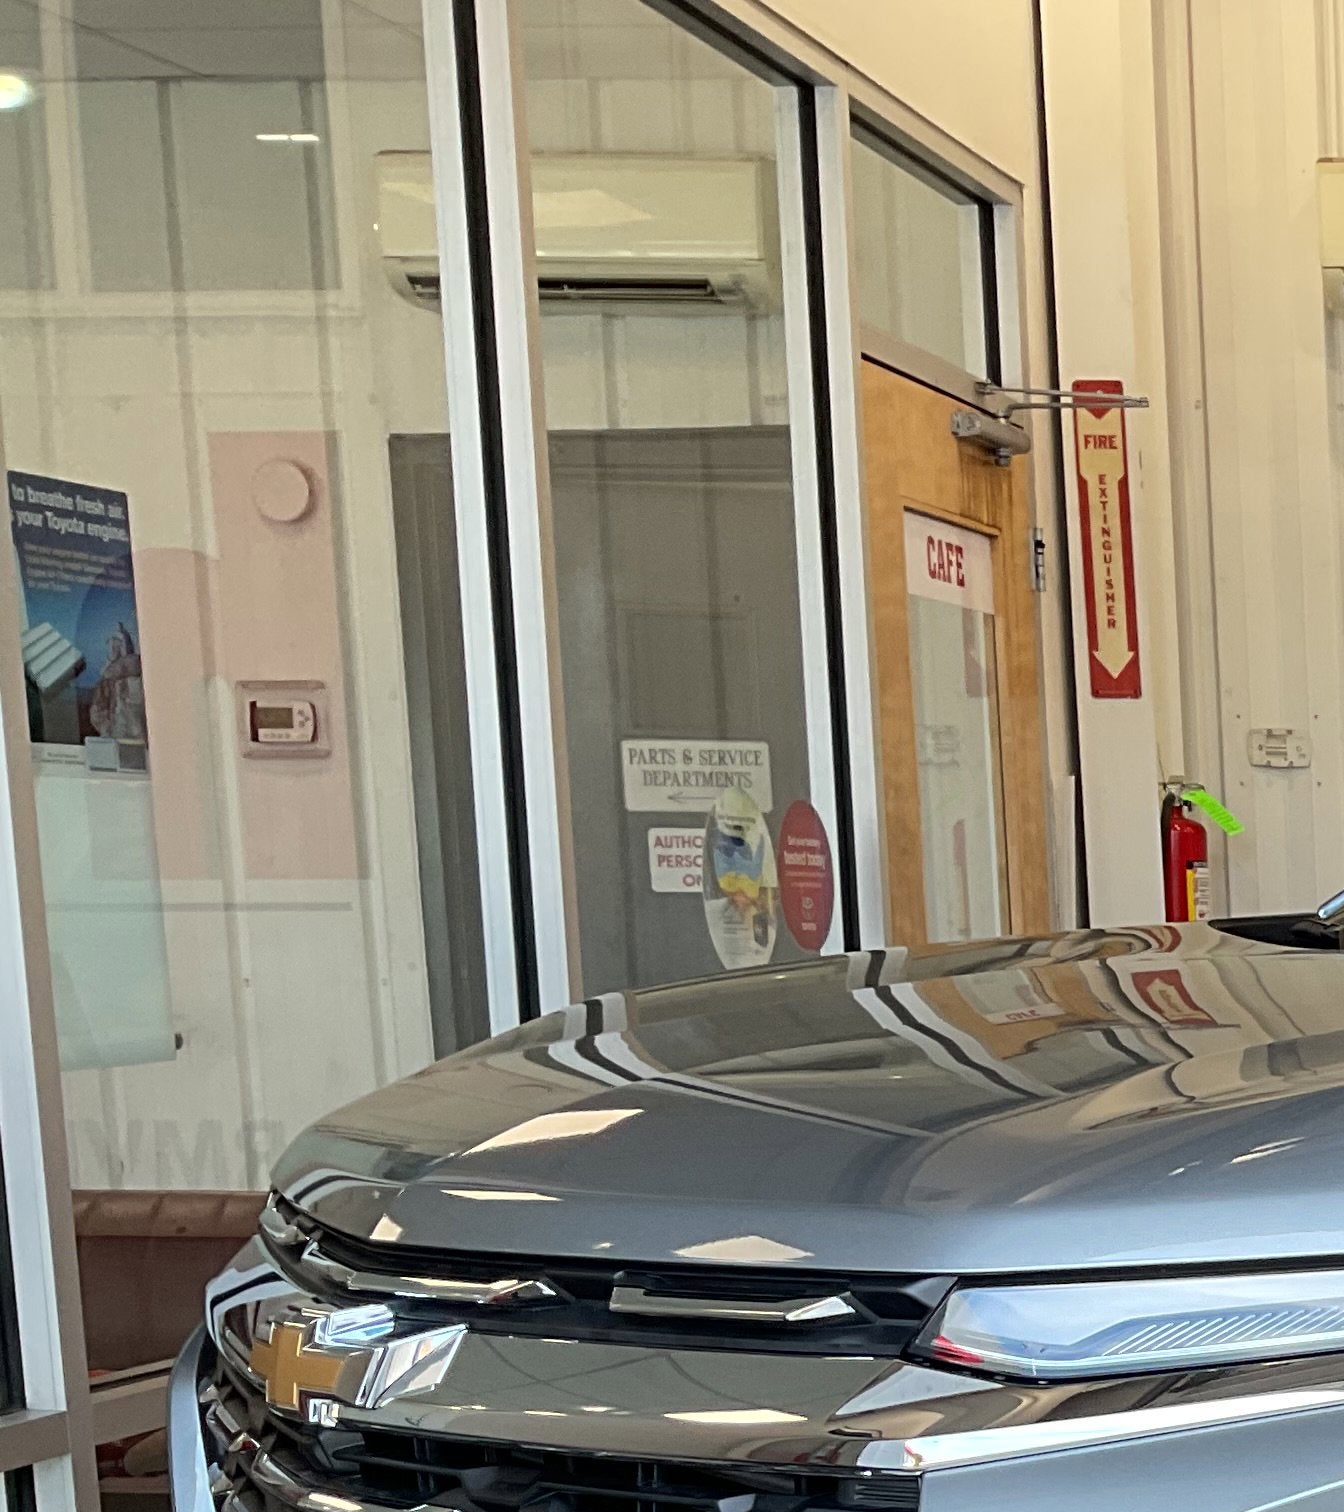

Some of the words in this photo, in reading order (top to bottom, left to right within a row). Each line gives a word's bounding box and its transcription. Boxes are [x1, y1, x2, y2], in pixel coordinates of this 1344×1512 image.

[1083, 433, 1118, 451] FIRE
[16, 510, 43, 527] your
[44, 511, 85, 534] Toyota
[1097, 473, 1117, 630] EXTINGUISHER
[926, 535, 966, 589] CAFE
[628, 748, 677, 765] PARTS
[682, 750, 694, 766] &
[699, 749, 764, 766] SERVICE
[642, 770, 753, 788] DEPARTMENTS
[654, 835, 704, 849] AUTHO
[657, 854, 703, 868] PERSO
